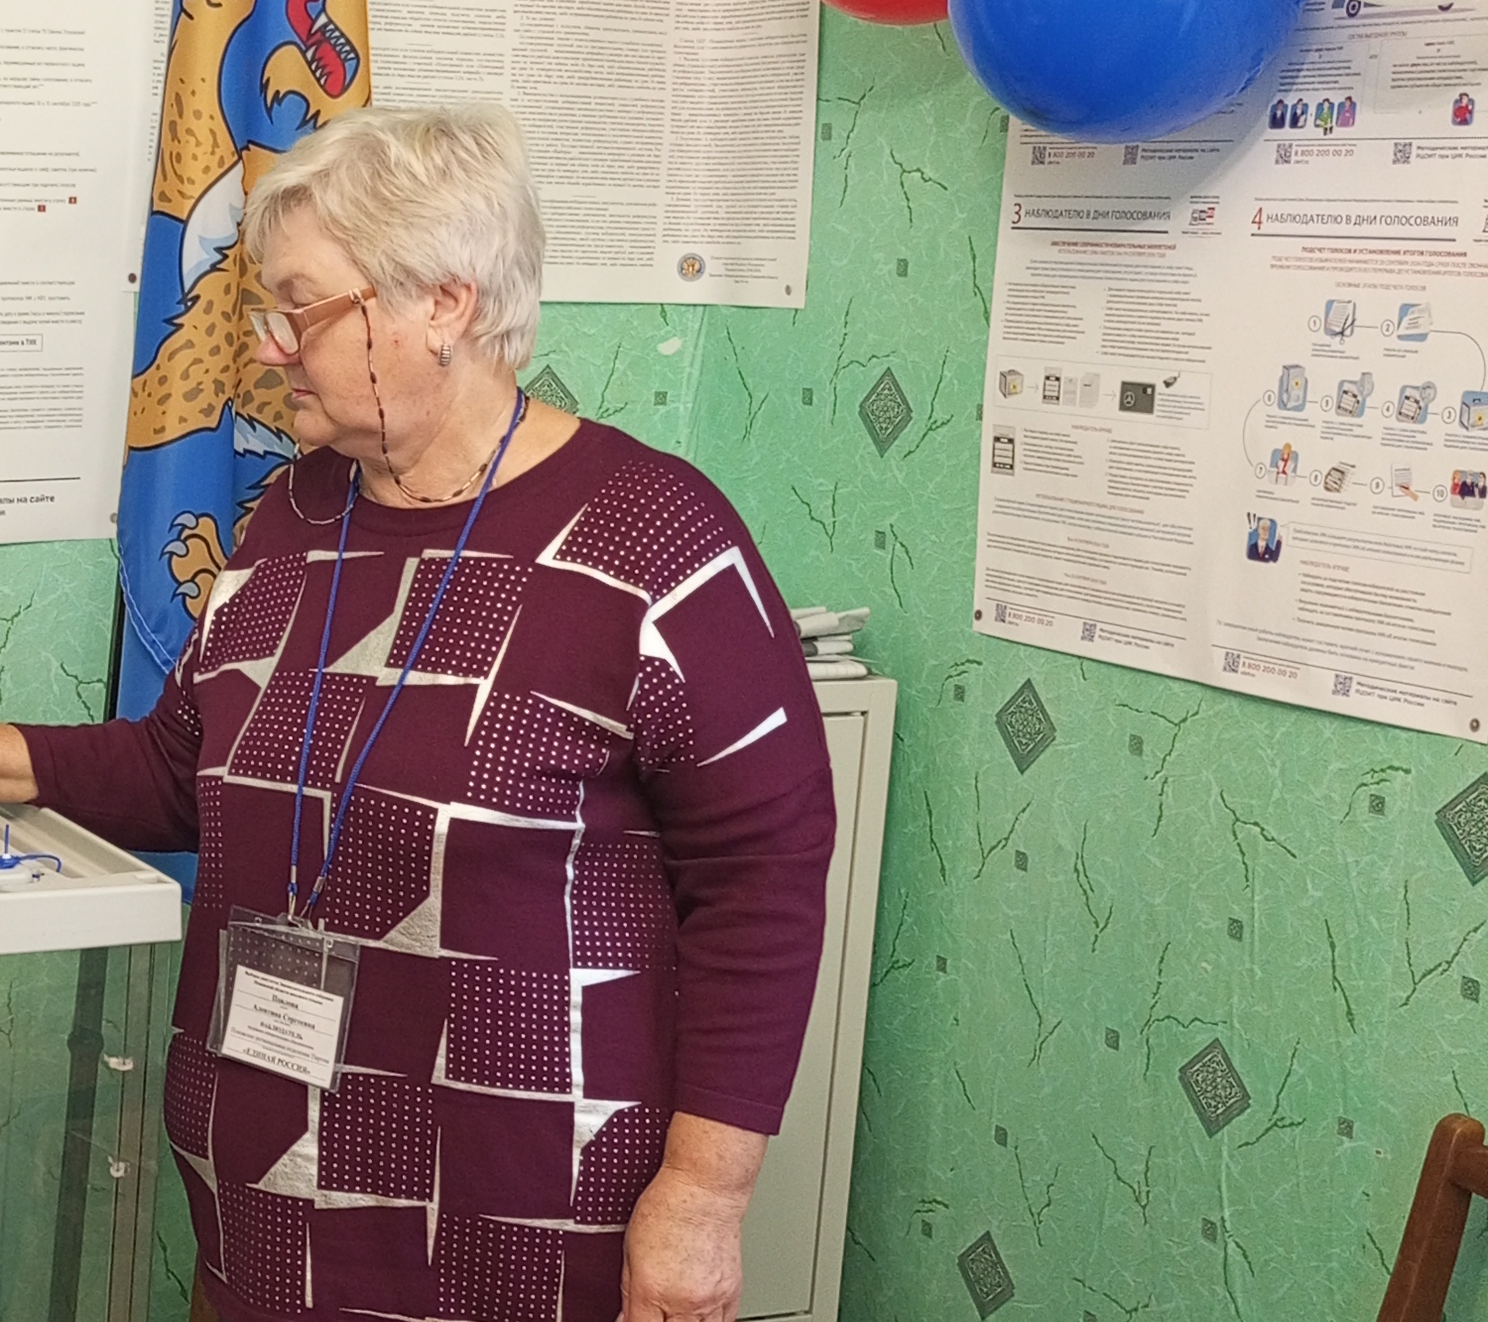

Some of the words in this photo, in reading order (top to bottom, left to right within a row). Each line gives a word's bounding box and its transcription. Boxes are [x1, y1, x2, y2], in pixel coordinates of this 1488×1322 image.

[1011, 203, 1022, 224] 3
[1024, 208, 1083, 220] НАБЛЮДАТЕЛЮ
[1085, 210, 1091, 219] В
[1092, 210, 1110, 221] ДНИ
[1111, 210, 1171, 221] ГОЛОСОВАНИЯ
[1251, 207, 1263, 230] 4
[1266, 213, 1343, 225] НАБЛЮДАТЕЛЮ
[1345, 215, 1352, 225] В
[1353, 215, 1377, 227] ДНИ
[1379, 215, 1459, 227] ГОЛОСОВАНИЯ
[1385, 404, 1391, 414] 4
[1446, 410, 1452, 420] 3
[1258, 466, 1263, 475] 7
[1375, 480, 1380, 490] 9
[1436, 488, 1445, 498] 10
[16, 496, 28, 504] на
[29, 494, 55, 503] сайте
